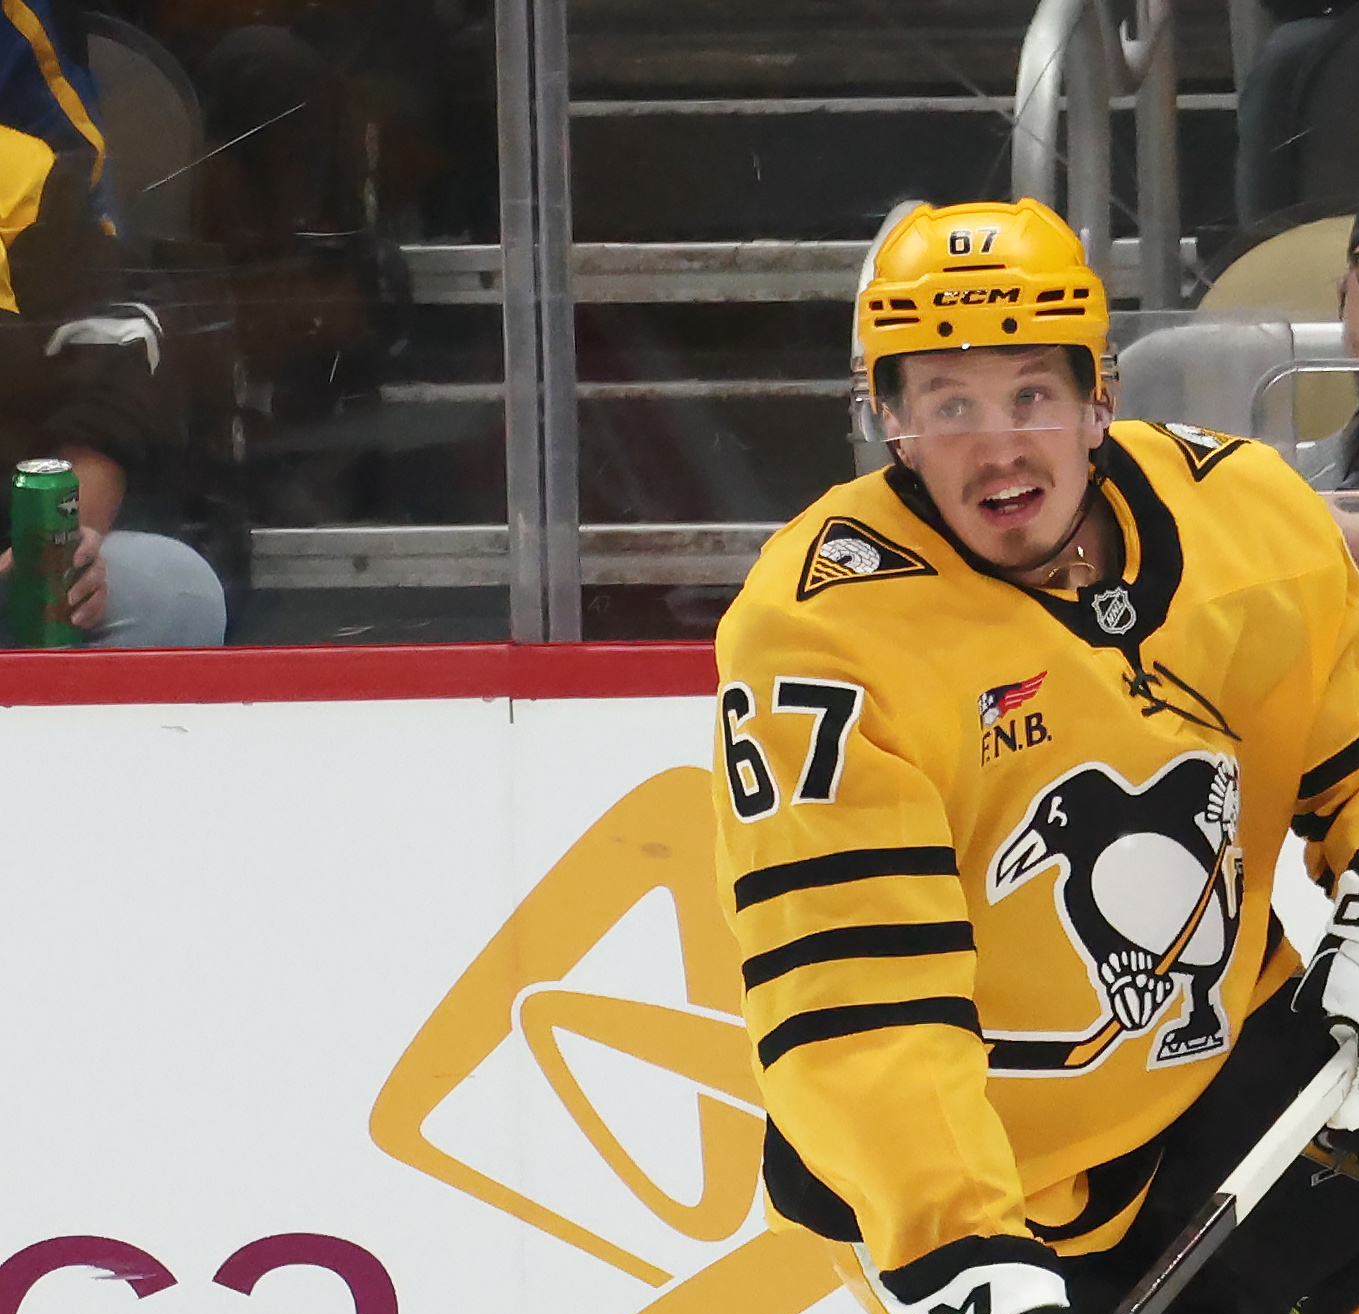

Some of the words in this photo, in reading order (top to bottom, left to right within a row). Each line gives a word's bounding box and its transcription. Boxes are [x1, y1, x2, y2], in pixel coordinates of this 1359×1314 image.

[947, 226, 1000, 257] 67
[933, 287, 1021, 307] CCM
[719, 675, 865, 825] 67
[979, 711, 1054, 769] F.N.B.
